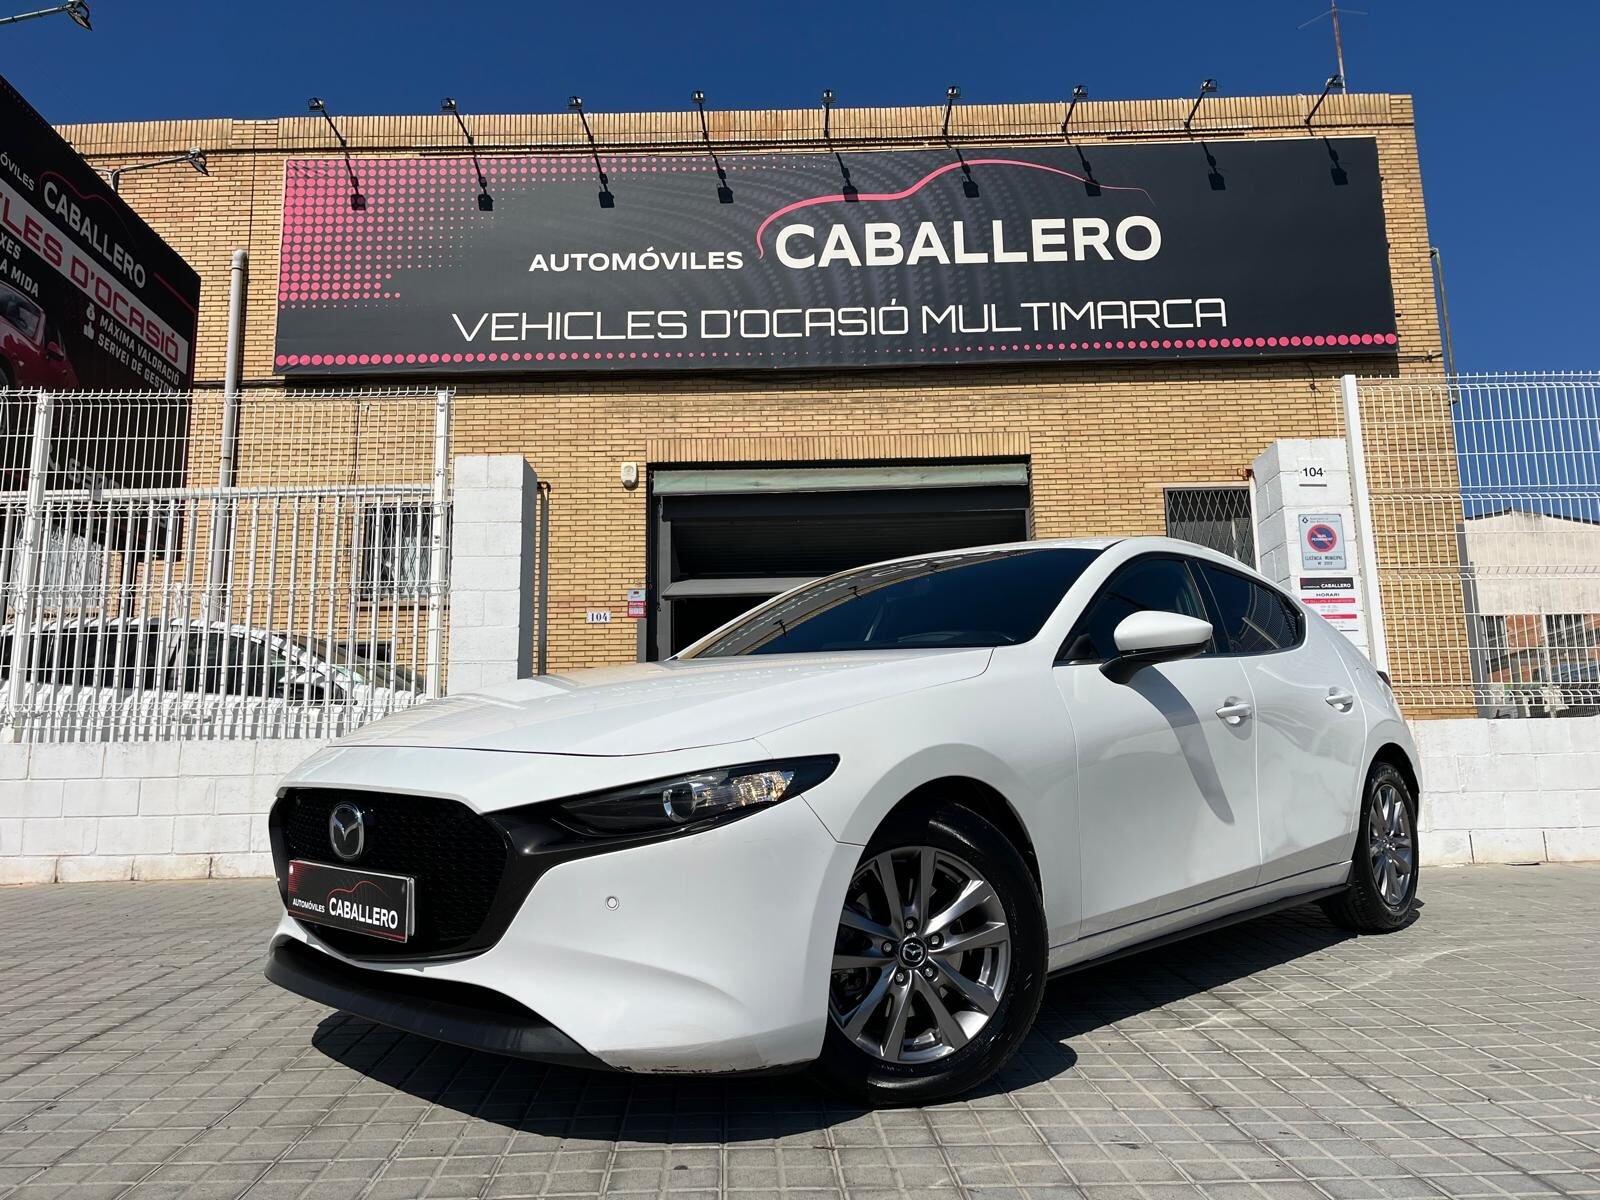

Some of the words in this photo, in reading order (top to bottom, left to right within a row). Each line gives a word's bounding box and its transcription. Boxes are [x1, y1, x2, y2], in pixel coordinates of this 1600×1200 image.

[44, 181, 146, 289] CABALLERO
[528, 246, 744, 272] AUTOMÓVILES
[775, 215, 1163, 269] CABALLERO
[0, 191, 63, 267] LES
[70, 255, 179, 364] D'OCASIÓ
[10, 265, 39, 298] MIDA
[451, 310, 688, 342] VEHICLES
[701, 298, 909, 339] D'OCASIÓ
[921, 298, 1227, 334] MULTIMARCA
[97, 333, 129, 366] SERVEI
[130, 358, 143, 376] DE
[137, 343, 179, 385] VALORACIÓ
[1302, 467, 1324, 477] 104
[591, 613, 608, 622] 104
[292, 897, 325, 914] AUTOMÓVILES
[328, 897, 399, 929] CABALLERO
